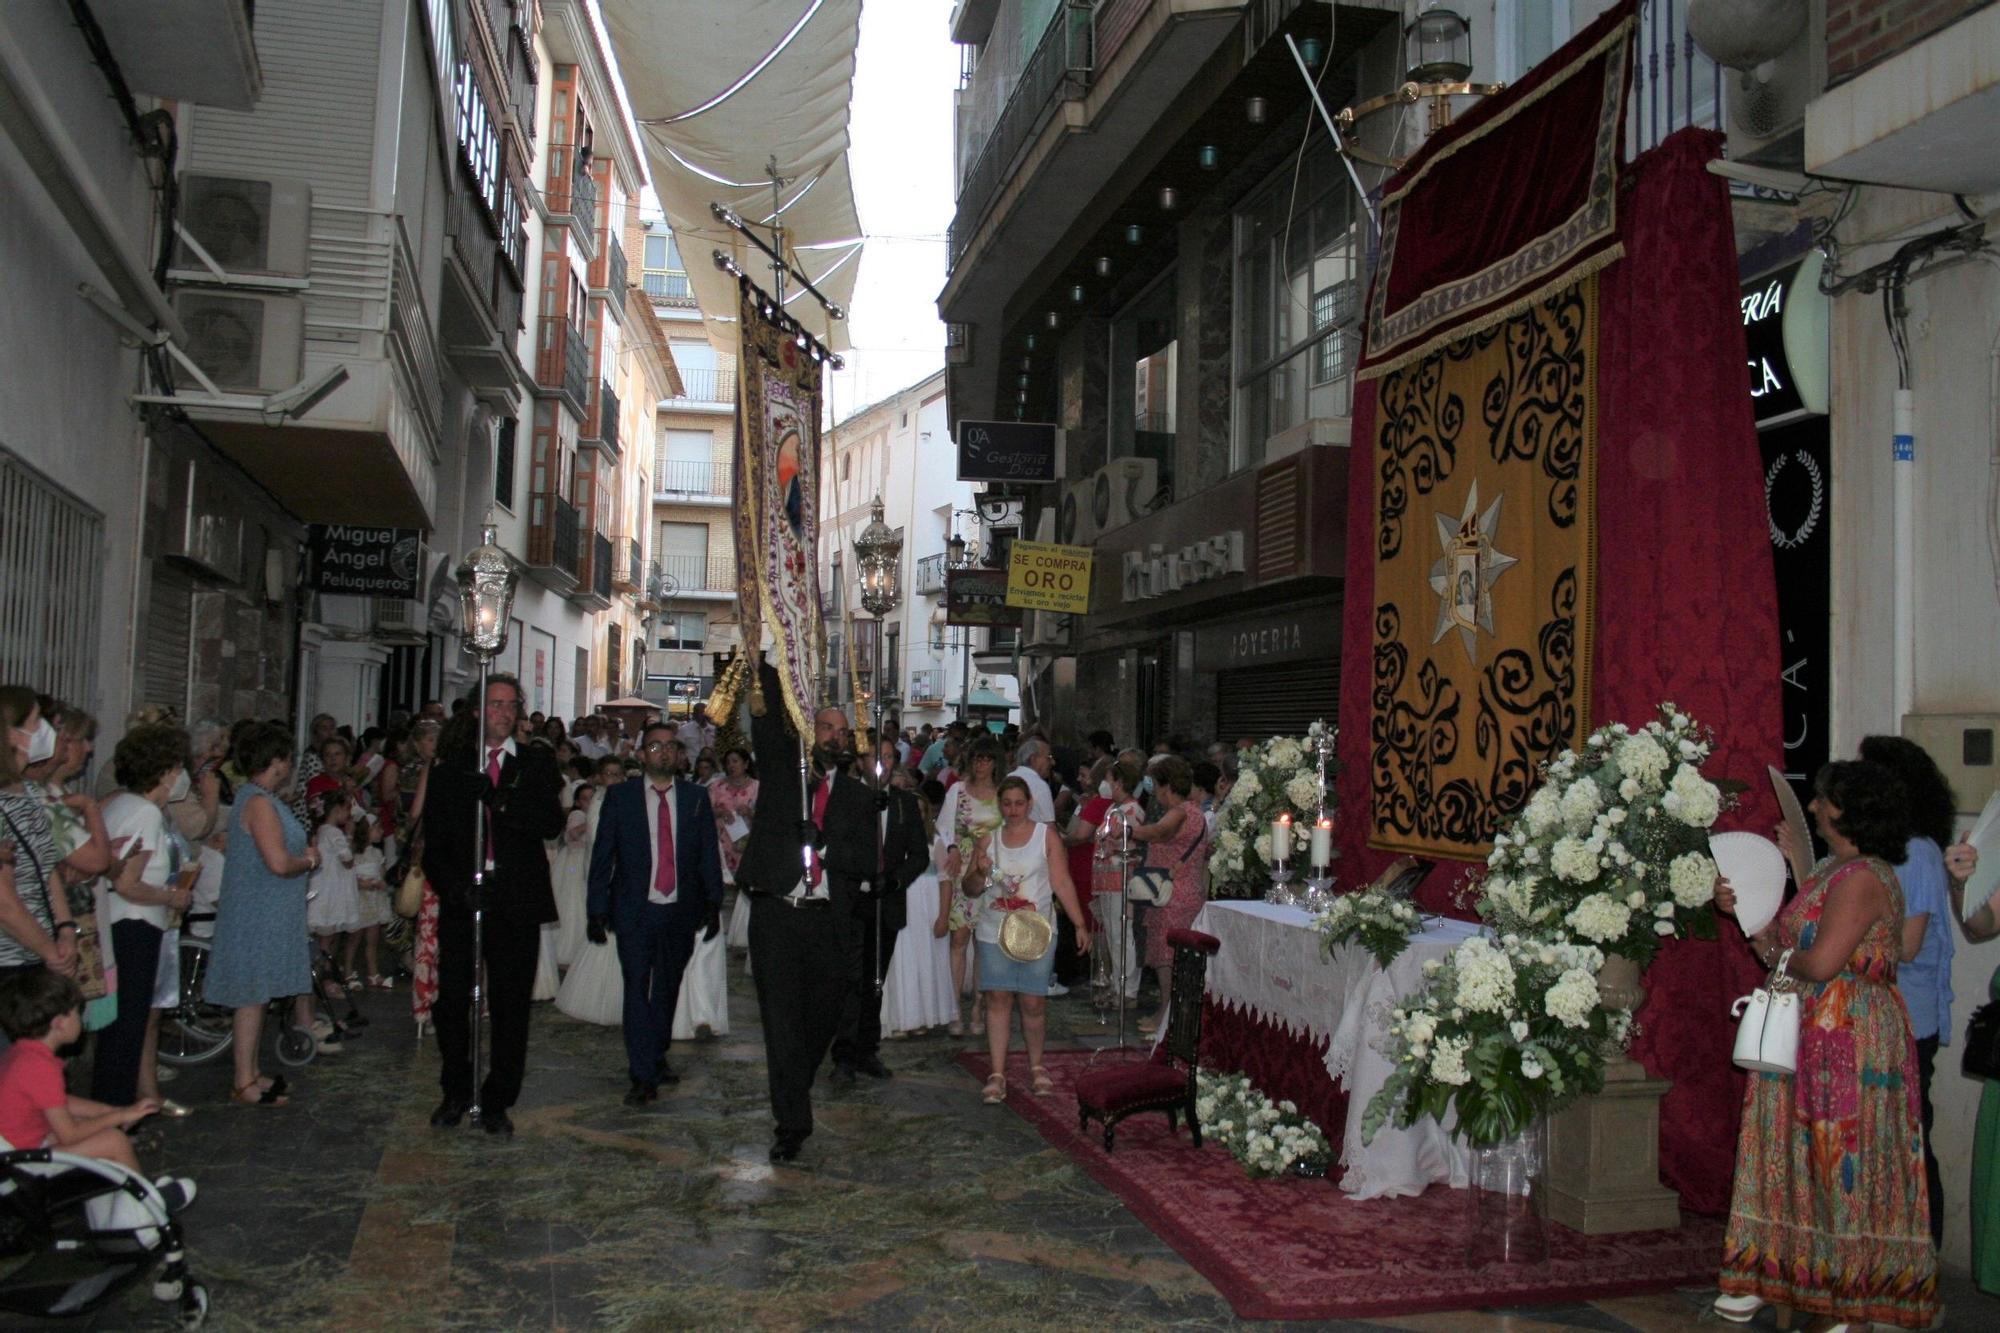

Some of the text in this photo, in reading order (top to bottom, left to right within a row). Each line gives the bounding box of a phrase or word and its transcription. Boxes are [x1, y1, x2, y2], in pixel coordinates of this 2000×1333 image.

[325, 525, 397, 546] Miguel
[324, 542, 385, 570] Ángel
[1014, 553, 1087, 572] SE COMPRA
[321, 571, 409, 591] Peluqueros
[1024, 569, 1073, 591] ORO
[1010, 587, 1046, 598] Enviamos
[1231, 624, 1301, 657] JOYERIA
